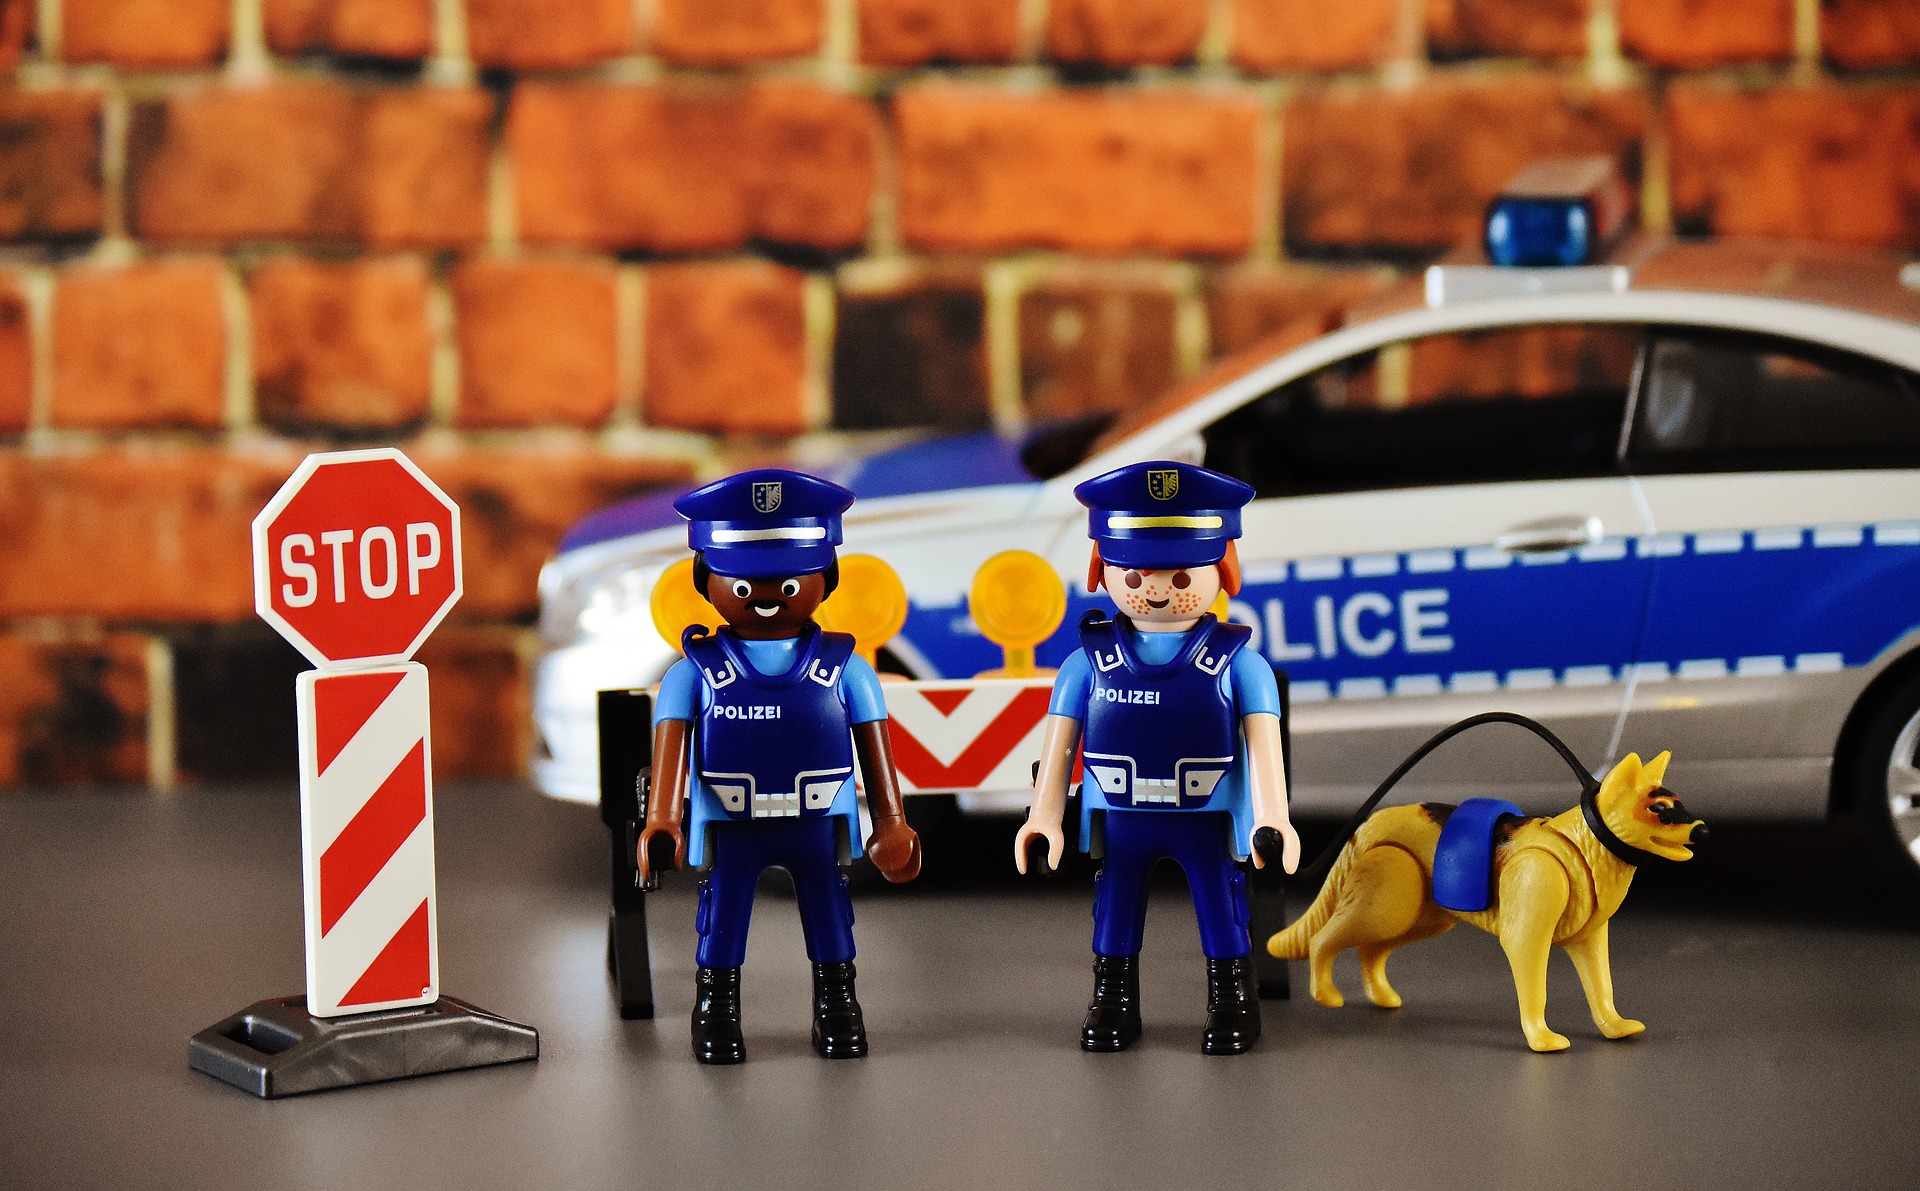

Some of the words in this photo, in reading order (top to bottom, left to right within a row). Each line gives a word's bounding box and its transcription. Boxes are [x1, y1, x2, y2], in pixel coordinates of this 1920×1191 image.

[281, 521, 441, 608] STOP
[1228, 588, 1455, 662] LICE
[713, 705, 781, 720] POLIZEI
[1095, 688, 1160, 705] POLIZEI
